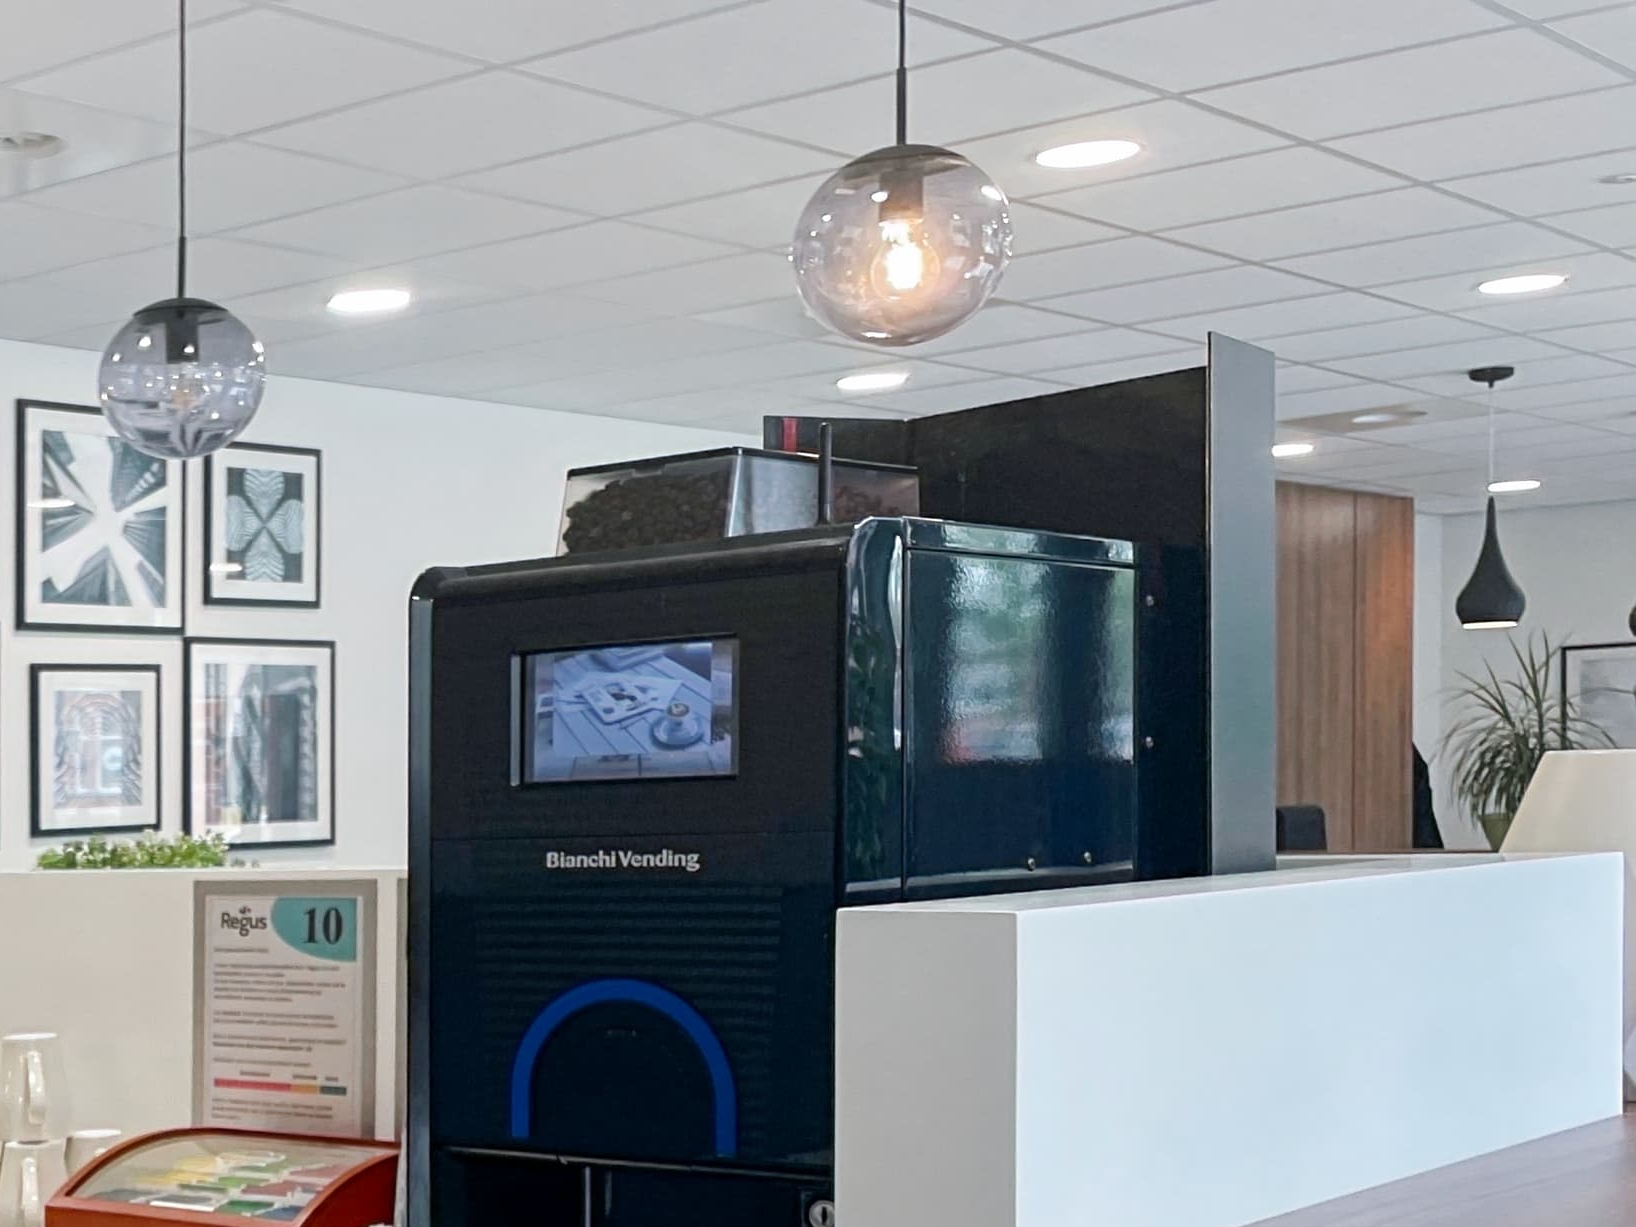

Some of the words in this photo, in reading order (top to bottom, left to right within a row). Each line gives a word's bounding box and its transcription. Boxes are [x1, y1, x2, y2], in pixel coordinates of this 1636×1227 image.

[546, 850, 616, 869] Bianchi
[618, 849, 701, 872] Vending
[220, 911, 268, 937] Regus
[303, 906, 344, 945] 10
